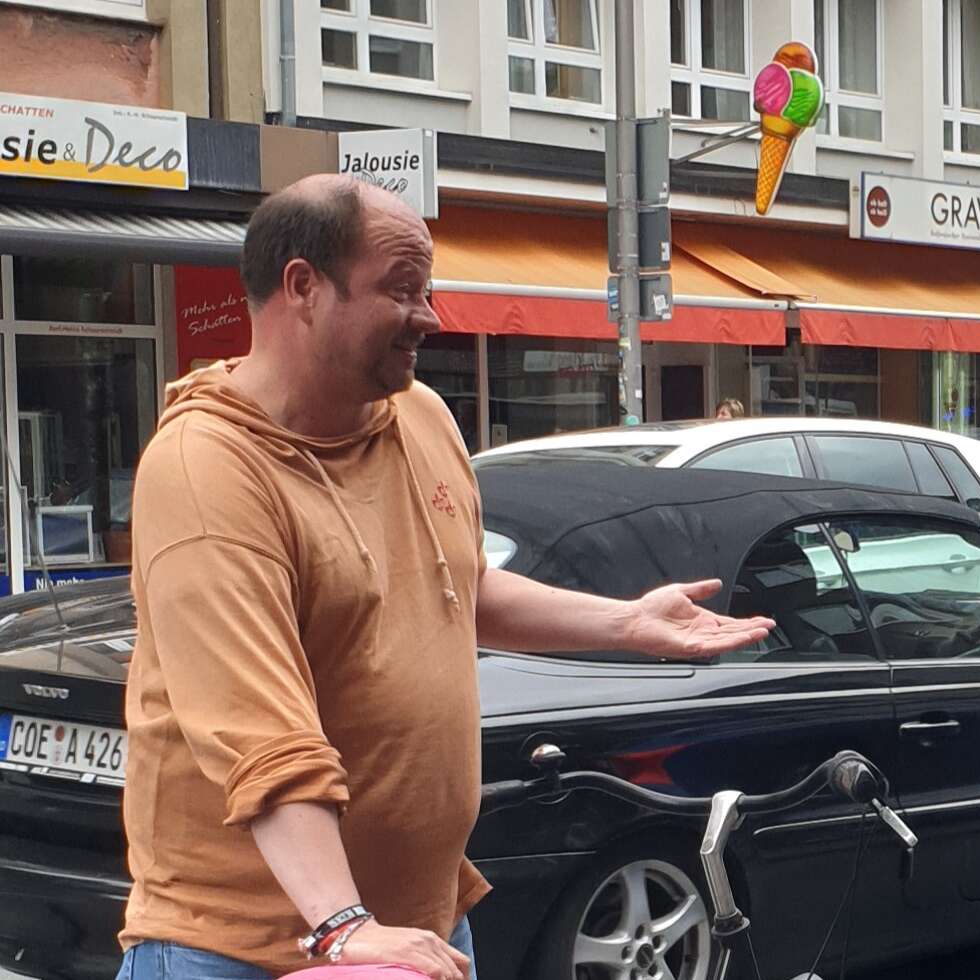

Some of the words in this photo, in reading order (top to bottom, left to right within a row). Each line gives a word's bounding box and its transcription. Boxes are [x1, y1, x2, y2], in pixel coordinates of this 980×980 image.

[1, 129, 58, 165] sie
[63, 142, 76, 162] &
[84, 116, 183, 173] Deco
[340, 150, 420, 174] Jalousie
[22, 683, 70, 699] VOLVO
[11, 720, 52, 760] COE
[64, 727, 78, 764] A
[84, 730, 122, 771] 426
